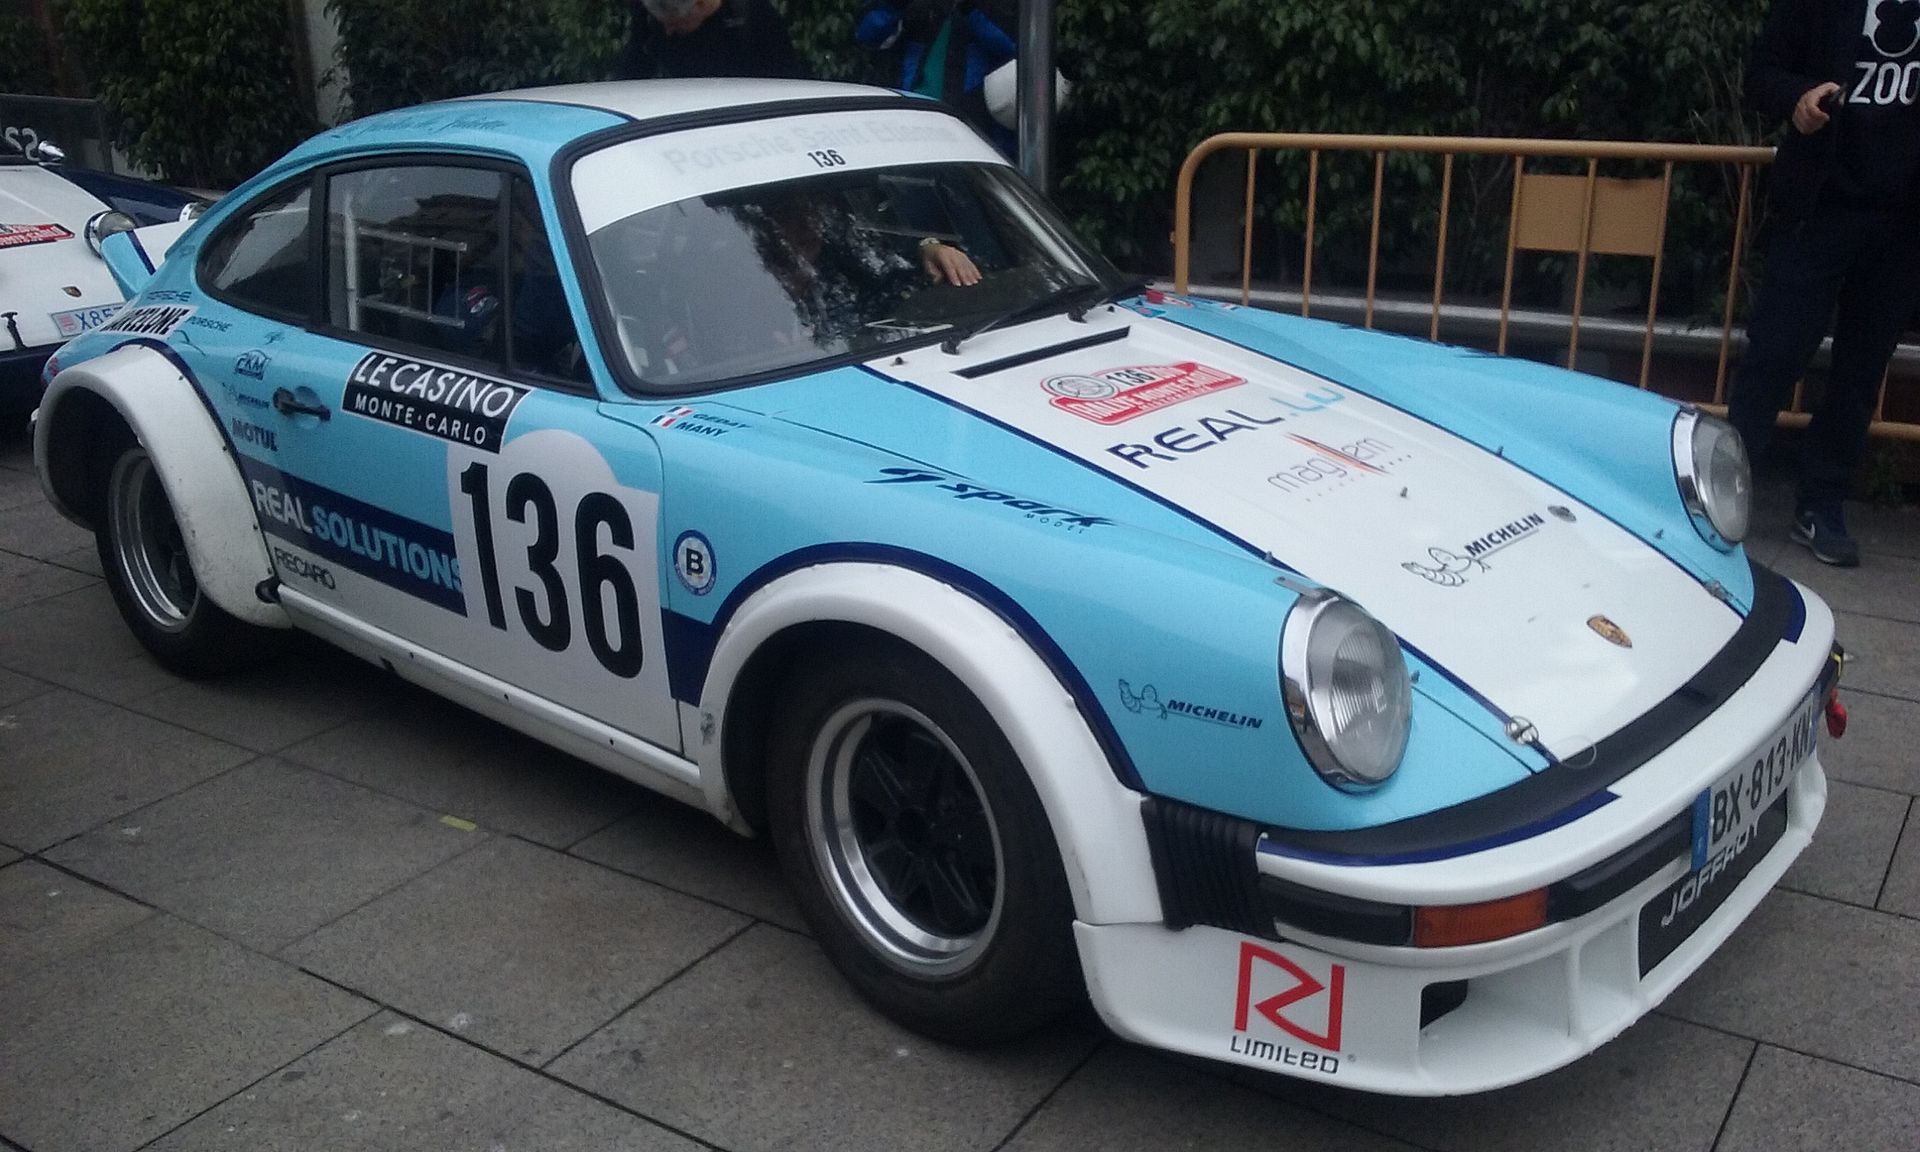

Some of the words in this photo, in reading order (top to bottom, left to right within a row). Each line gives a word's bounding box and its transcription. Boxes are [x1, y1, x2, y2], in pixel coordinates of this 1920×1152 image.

[807, 149, 846, 170] 136
[355, 355, 398, 386] LE
[389, 363, 515, 418] CASINO
[1105, 369, 1157, 387] 136
[675, 421, 729, 437] MANY
[252, 479, 314, 535] REAL
[1464, 512, 1545, 558] MICHELIN
[275, 547, 337, 591] RECARO
[460, 460, 644, 680] 136
[685, 547, 704, 576] B
[1166, 699, 1264, 730] MICHELIN
